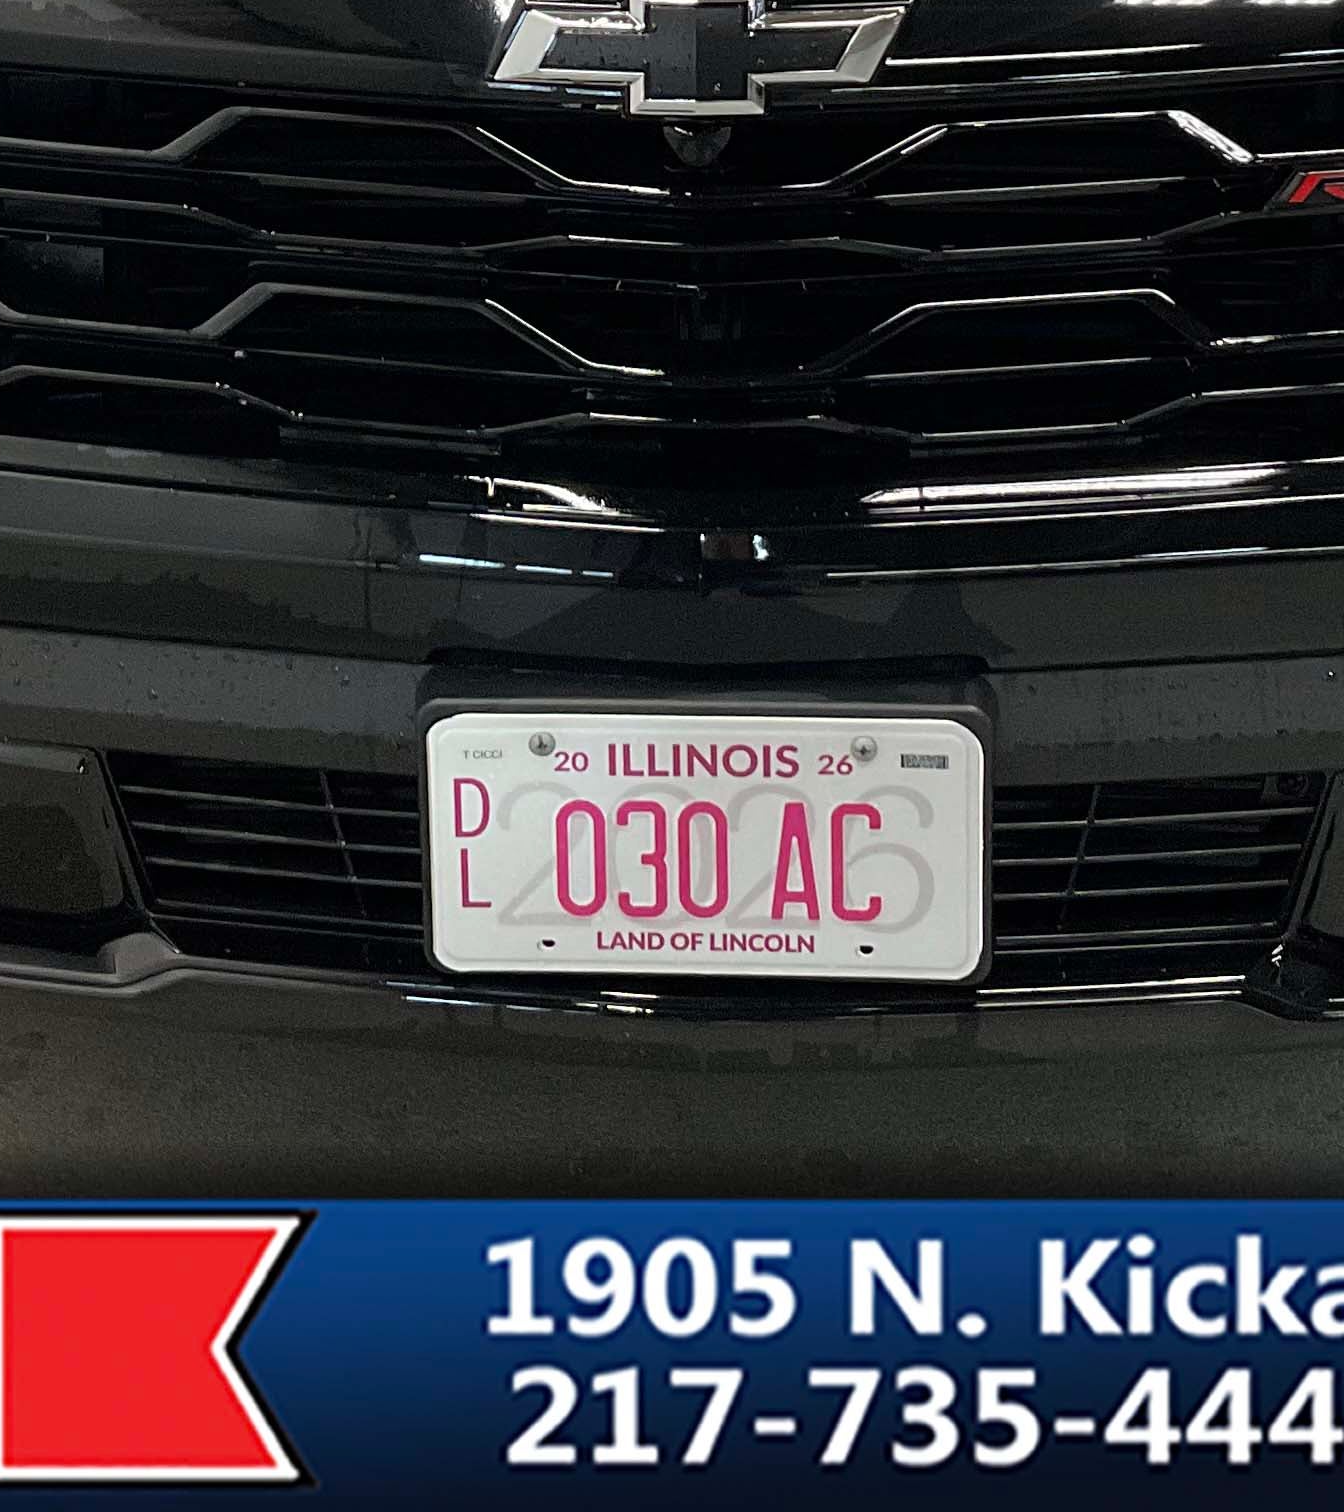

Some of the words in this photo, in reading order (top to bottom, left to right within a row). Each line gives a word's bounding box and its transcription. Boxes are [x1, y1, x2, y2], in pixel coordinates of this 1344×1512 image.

[554, 751, 589, 772] 20
[608, 743, 799, 778] ILLINOIS
[817, 754, 853, 776] 26
[554, 799, 730, 920] 030
[770, 801, 884, 924] AC
[596, 932, 665, 951] LAND
[670, 932, 705, 951] OF
[709, 934, 816, 954] LINCOLN
